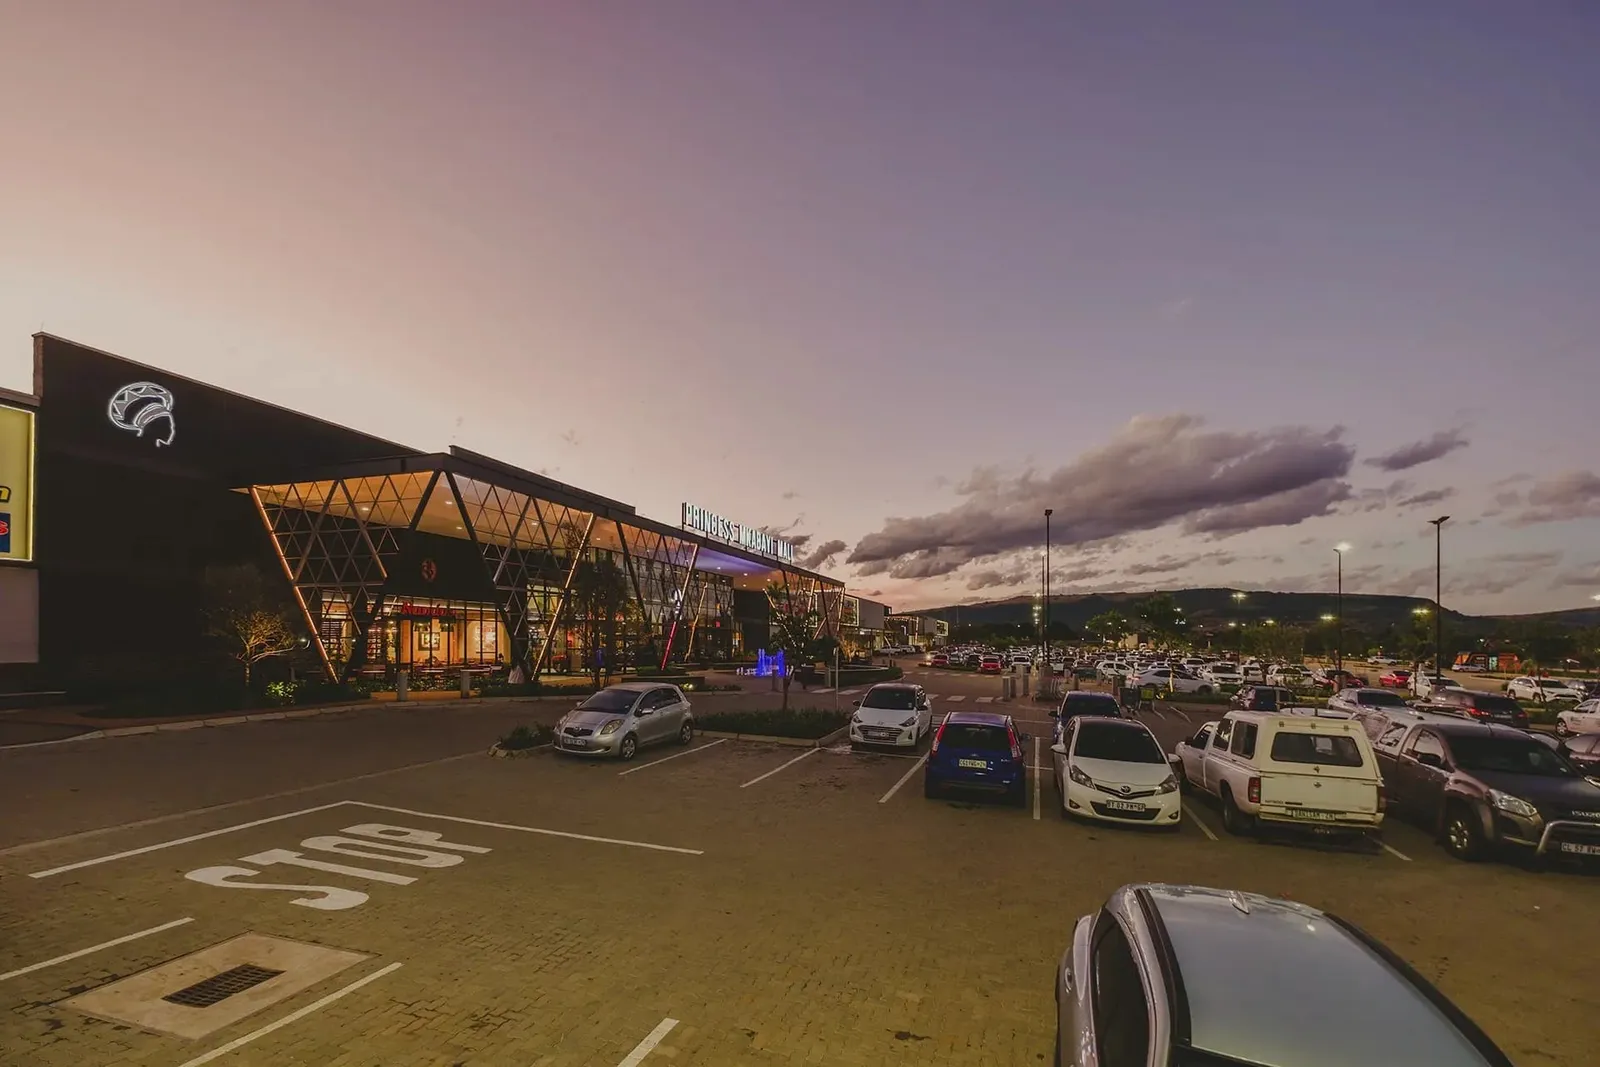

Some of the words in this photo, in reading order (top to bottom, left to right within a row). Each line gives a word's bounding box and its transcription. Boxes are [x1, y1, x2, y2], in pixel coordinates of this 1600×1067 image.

[685, 502, 735, 542] PRINCESS
[739, 524, 774, 555] MKABAYI
[184, 823, 493, 911] STOP
